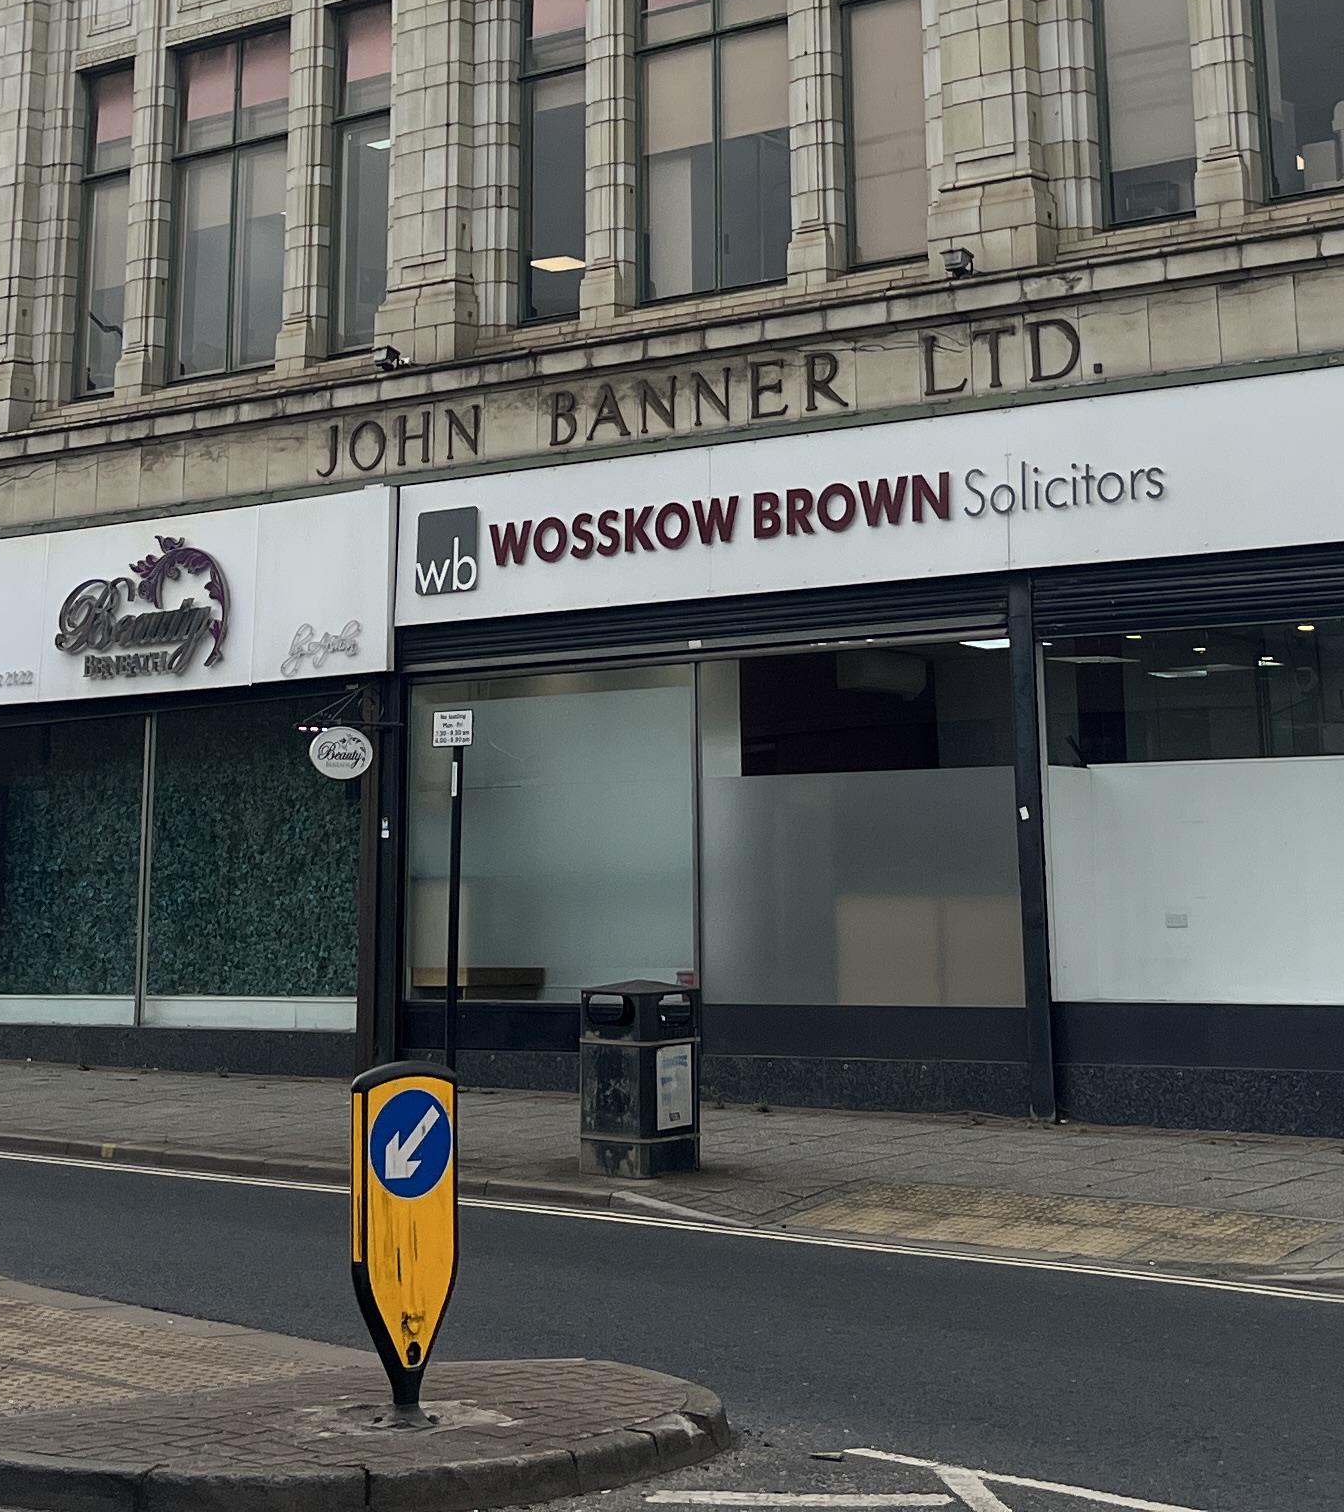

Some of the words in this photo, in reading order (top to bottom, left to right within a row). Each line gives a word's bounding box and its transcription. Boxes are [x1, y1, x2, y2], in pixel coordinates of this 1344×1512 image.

[316, 404, 482, 478] JOHN
[550, 352, 849, 447] BANNER
[923, 319, 1103, 396] LTD.
[490, 496, 739, 567] WOSSKOW
[753, 471, 951, 539] BROWN
[964, 460, 1166, 519] Solicitors
[416, 537, 477, 593] wb
[317, 741, 362, 769] Beauty
